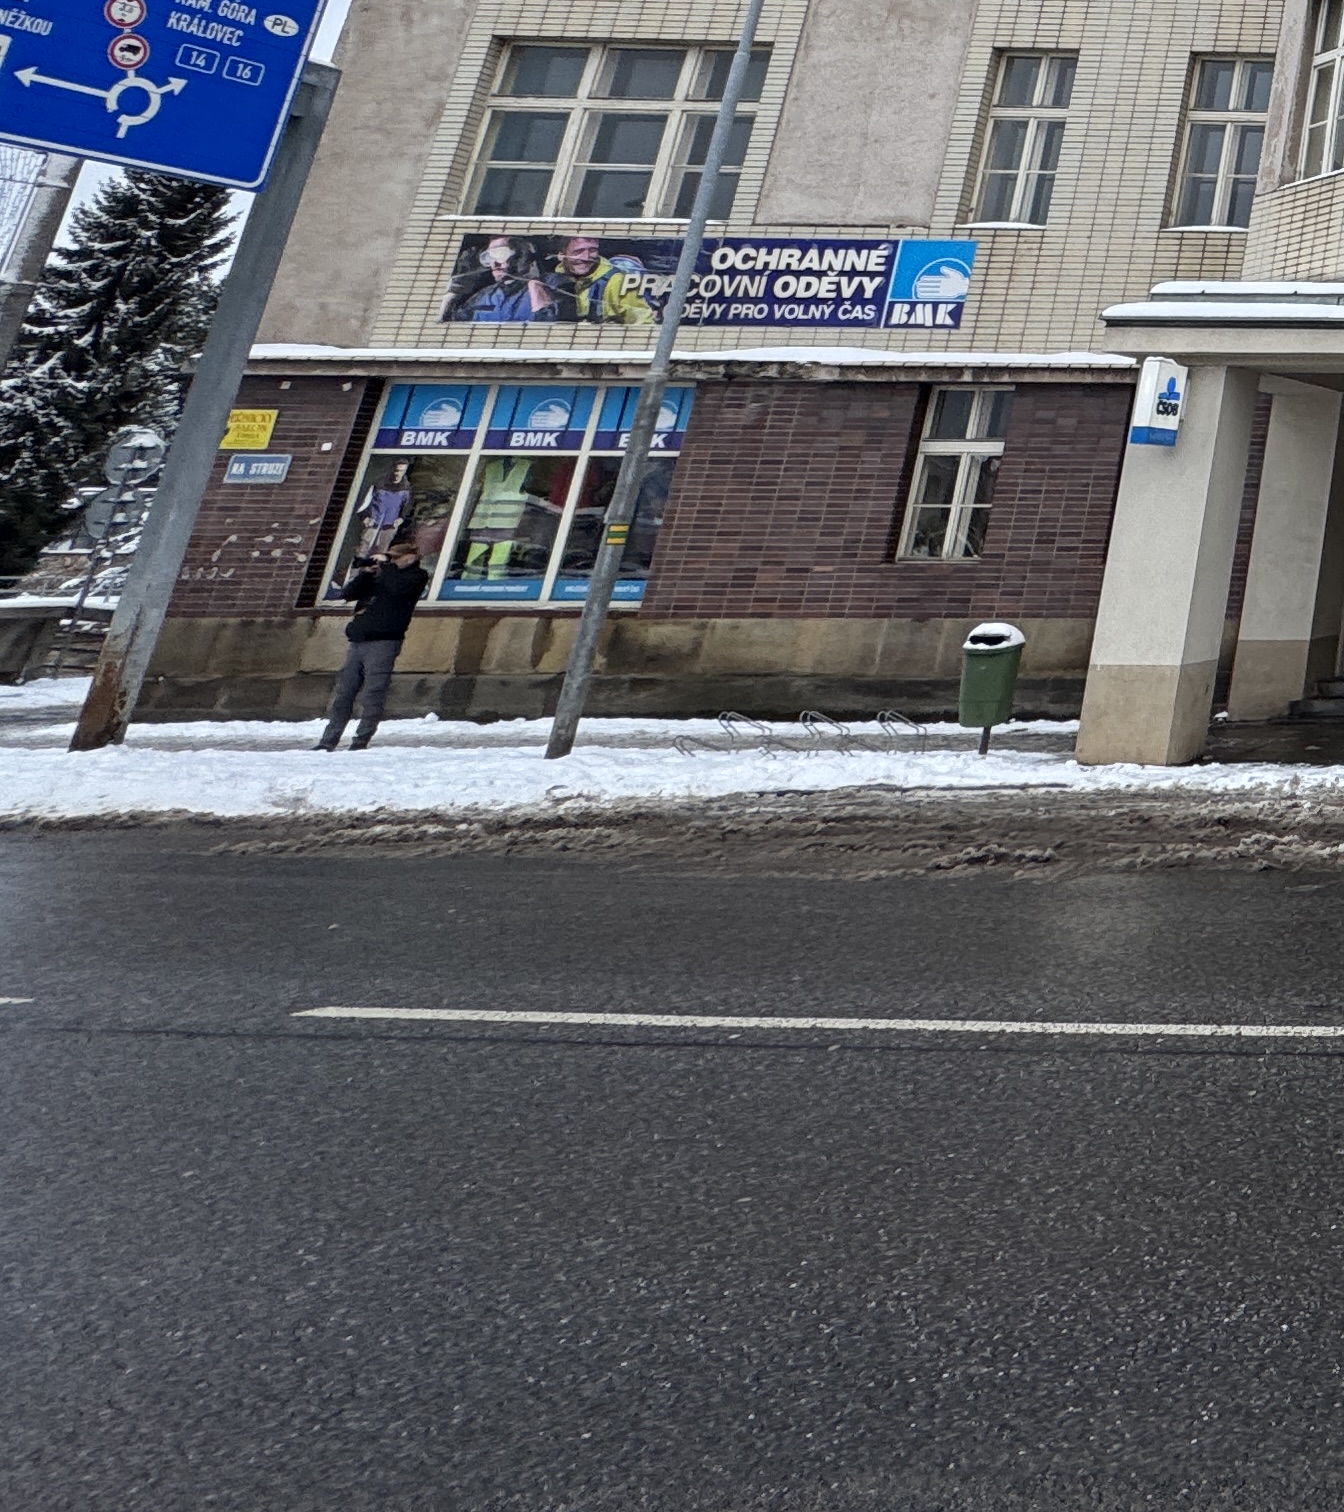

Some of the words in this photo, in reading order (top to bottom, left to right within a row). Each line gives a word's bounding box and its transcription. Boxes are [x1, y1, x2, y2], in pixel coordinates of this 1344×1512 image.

[217, 0, 257, 26] GÓRA
[166, 11, 245, 47] KRÁLOVEC
[271, 18, 290, 34] PL
[190, 51, 206, 67] 14
[237, 63, 253, 78] 16
[711, 243, 889, 272] OCHRANNÉ
[620, 271, 770, 298] PRACOVNÍ
[773, 271, 885, 299] ODĚVY
[680, 300, 727, 320] DĚVY
[727, 303, 769, 320] PRO
[774, 301, 836, 320] VOLNÝ
[838, 300, 877, 320] ČAS
[890, 303, 957, 327] BMK
[400, 431, 453, 447] BMK
[510, 431, 561, 448] BMK
[618, 433, 669, 449] BK
